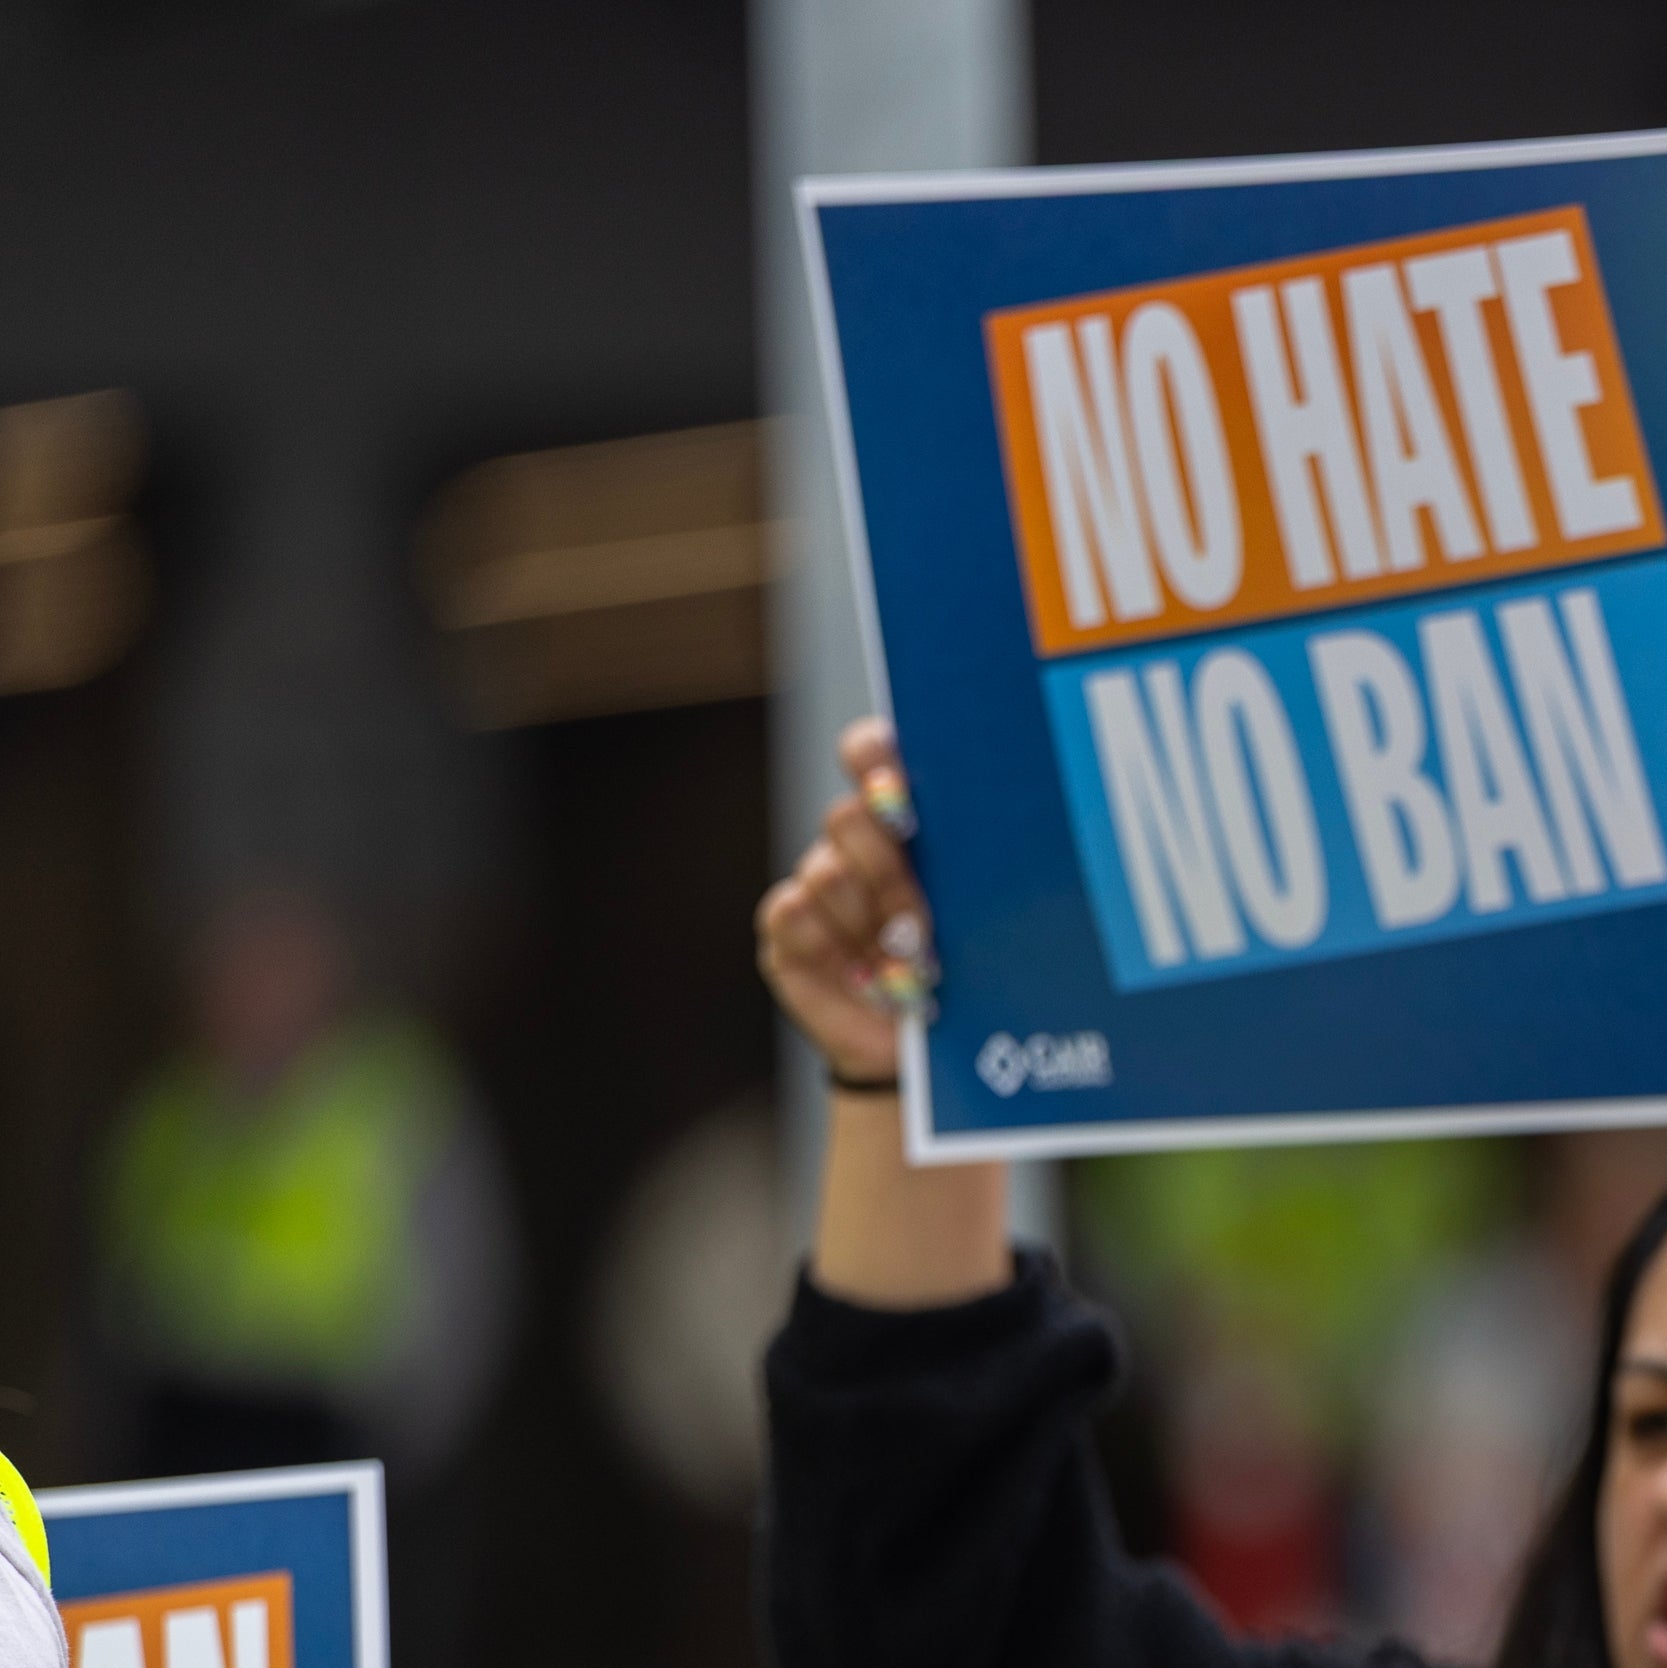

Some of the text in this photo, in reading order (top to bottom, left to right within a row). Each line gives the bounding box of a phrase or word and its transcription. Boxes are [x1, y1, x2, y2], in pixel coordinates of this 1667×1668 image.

[1023, 229, 1644, 630] NO HATE
[1084, 649, 1328, 968] NO
